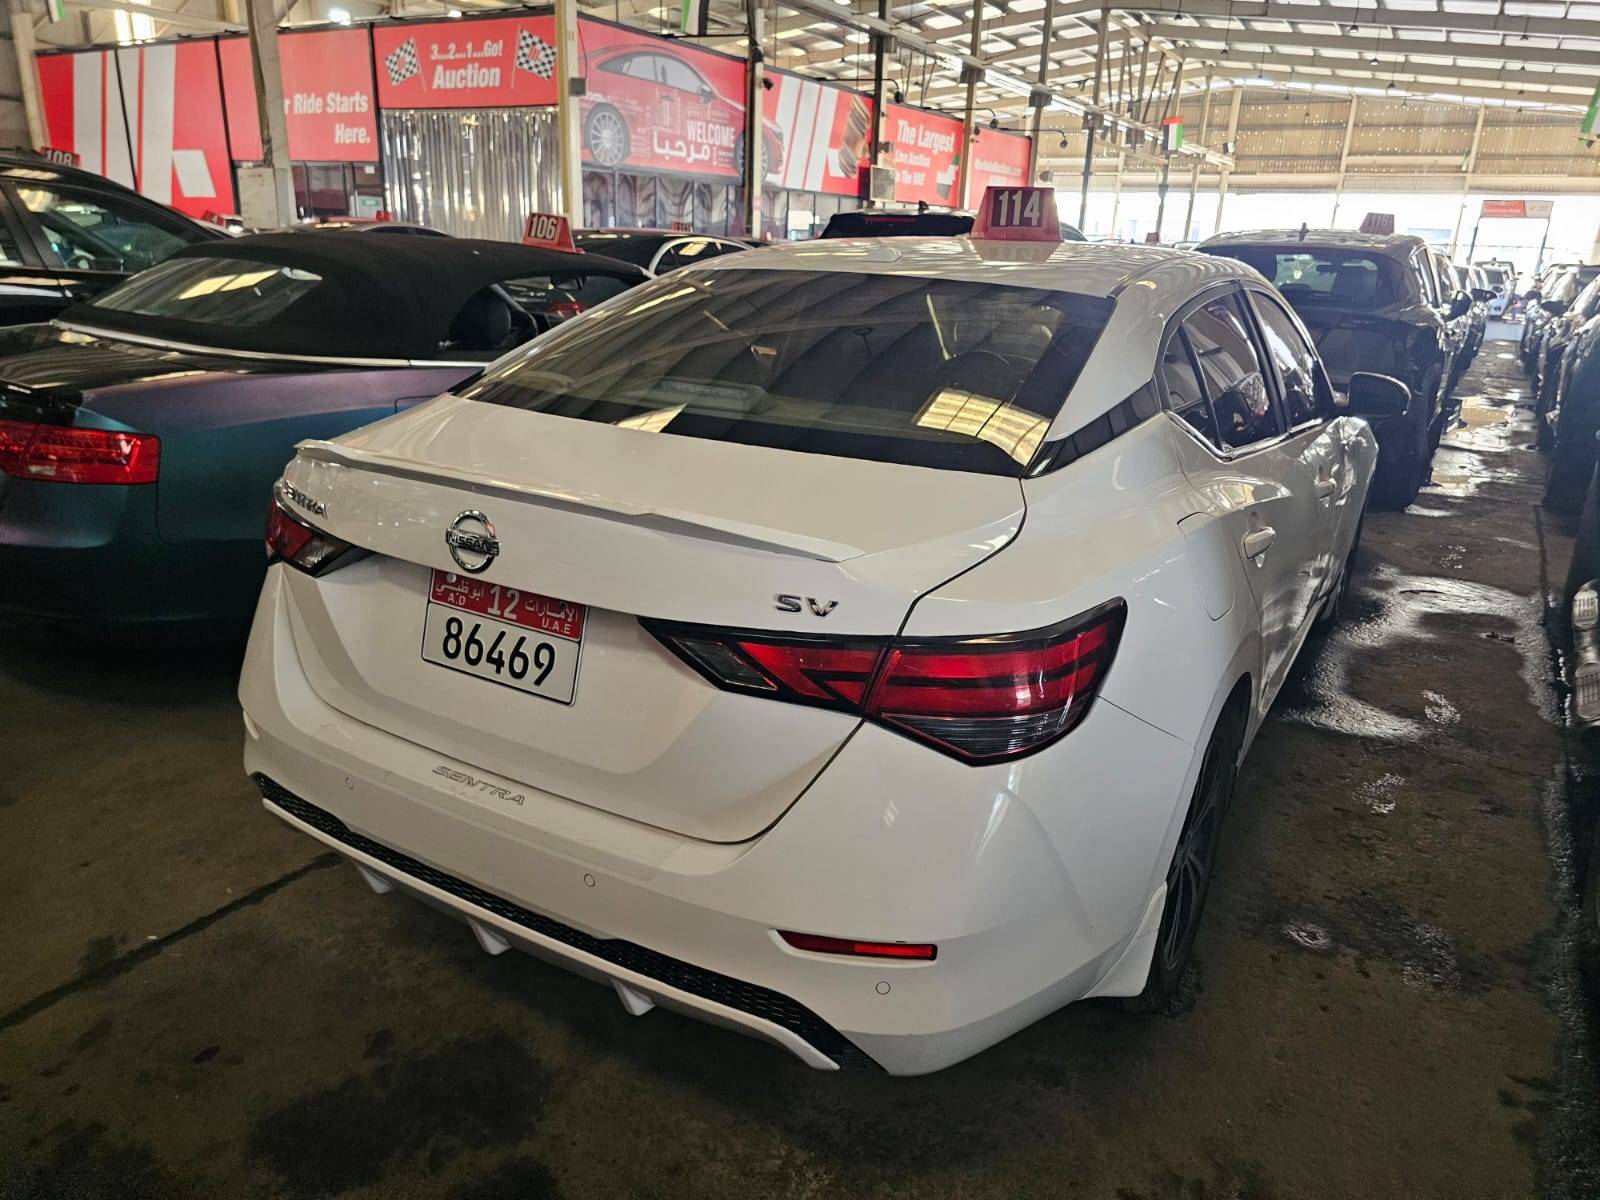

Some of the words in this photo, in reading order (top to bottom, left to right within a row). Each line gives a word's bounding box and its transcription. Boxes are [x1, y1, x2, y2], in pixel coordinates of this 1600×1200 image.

[432, 63, 501, 90] Auction
[293, 93, 323, 114] Ride
[326, 91, 369, 114] Starts
[335, 123, 371, 145] Here.
[686, 119, 736, 148] WELCOME
[897, 119, 917, 145] The
[917, 124, 956, 155] Largest
[45, 150, 74, 166] 108
[999, 190, 1041, 227] 114
[530, 214, 559, 241] 106
[447, 532, 494, 555] NISSAN
[487, 585, 521, 621] 12
[775, 594, 838, 617] SV
[442, 616, 556, 687] 86469
[431, 766, 525, 806] SENTRA
